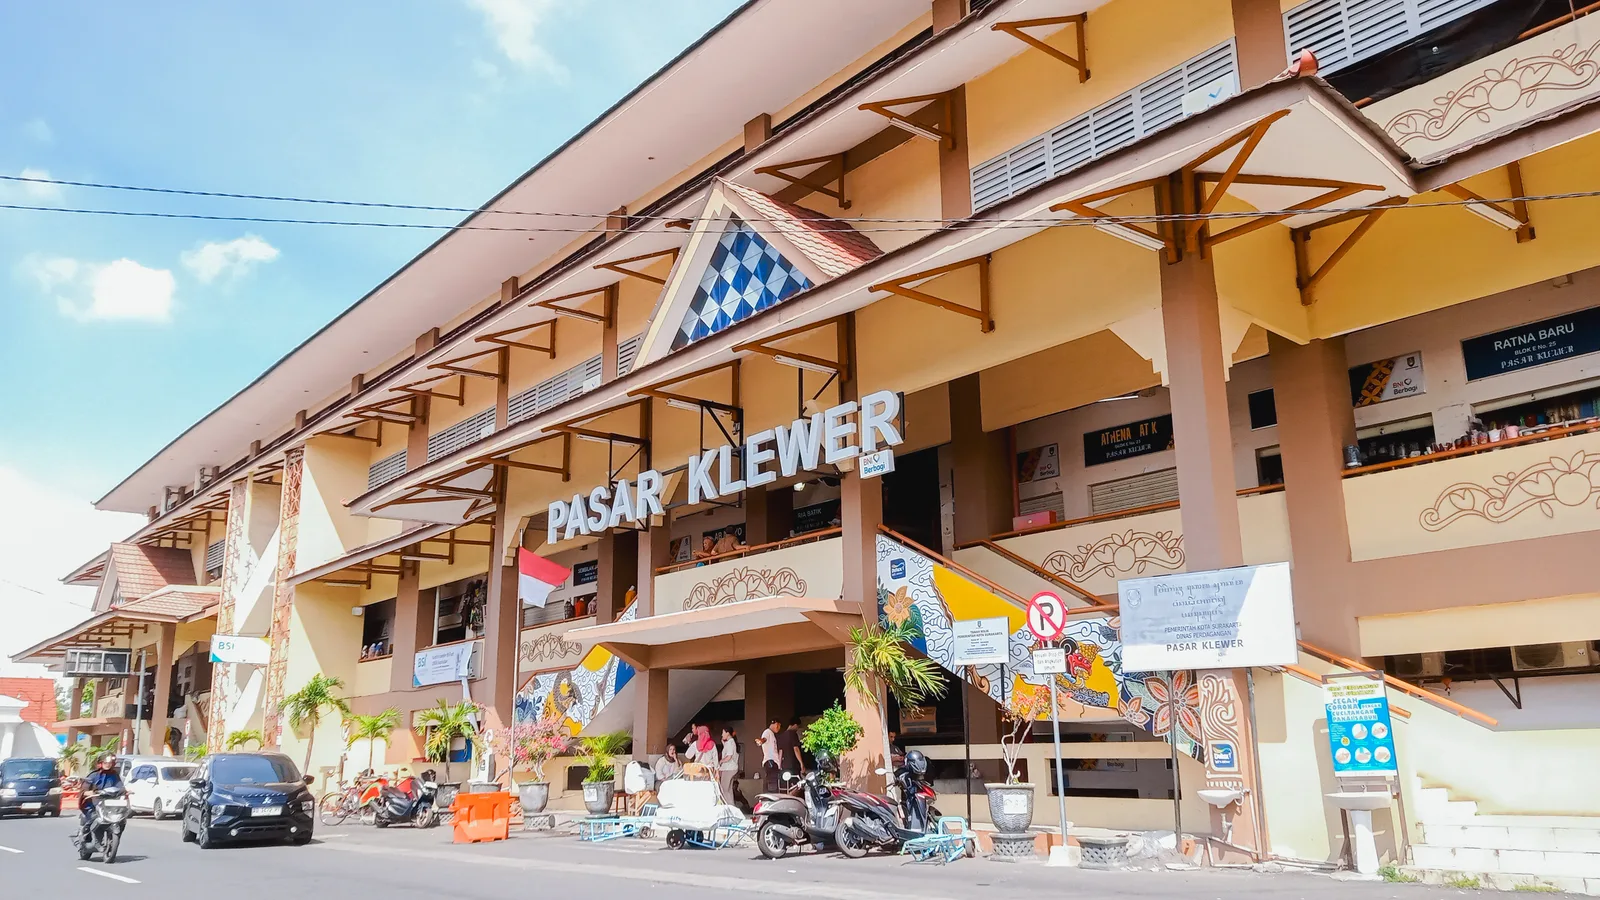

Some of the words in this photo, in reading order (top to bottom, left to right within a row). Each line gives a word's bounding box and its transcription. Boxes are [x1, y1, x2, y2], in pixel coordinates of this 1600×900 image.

[1494, 332, 1536, 351] RATNA
[1538, 322, 1575, 340] BARU
[1514, 347, 1532, 356] BLOK
[1548, 340, 1557, 348] 25
[1501, 355, 1534, 369] PASAR
[1392, 381, 1404, 389] BNI
[1393, 384, 1418, 395] Berbagi
[1101, 427, 1132, 446] ATHENA
[547, 469, 666, 545] PASAR
[688, 389, 904, 505] KLEWER
[864, 462, 886, 474] Berbagi
[807, 508, 822, 517] BATIK
[1039, 602, 1054, 631] P
[1164, 625, 1197, 633] PEMERINTAH
[1212, 621, 1242, 630] SURAKARTA
[1176, 632, 1192, 640] DINAS
[1193, 630, 1232, 639] PERDAGANGAN
[218, 641, 235, 650] BSI
[1166, 642, 1198, 652] PASAR
[1201, 639, 1244, 650] KLEWER
